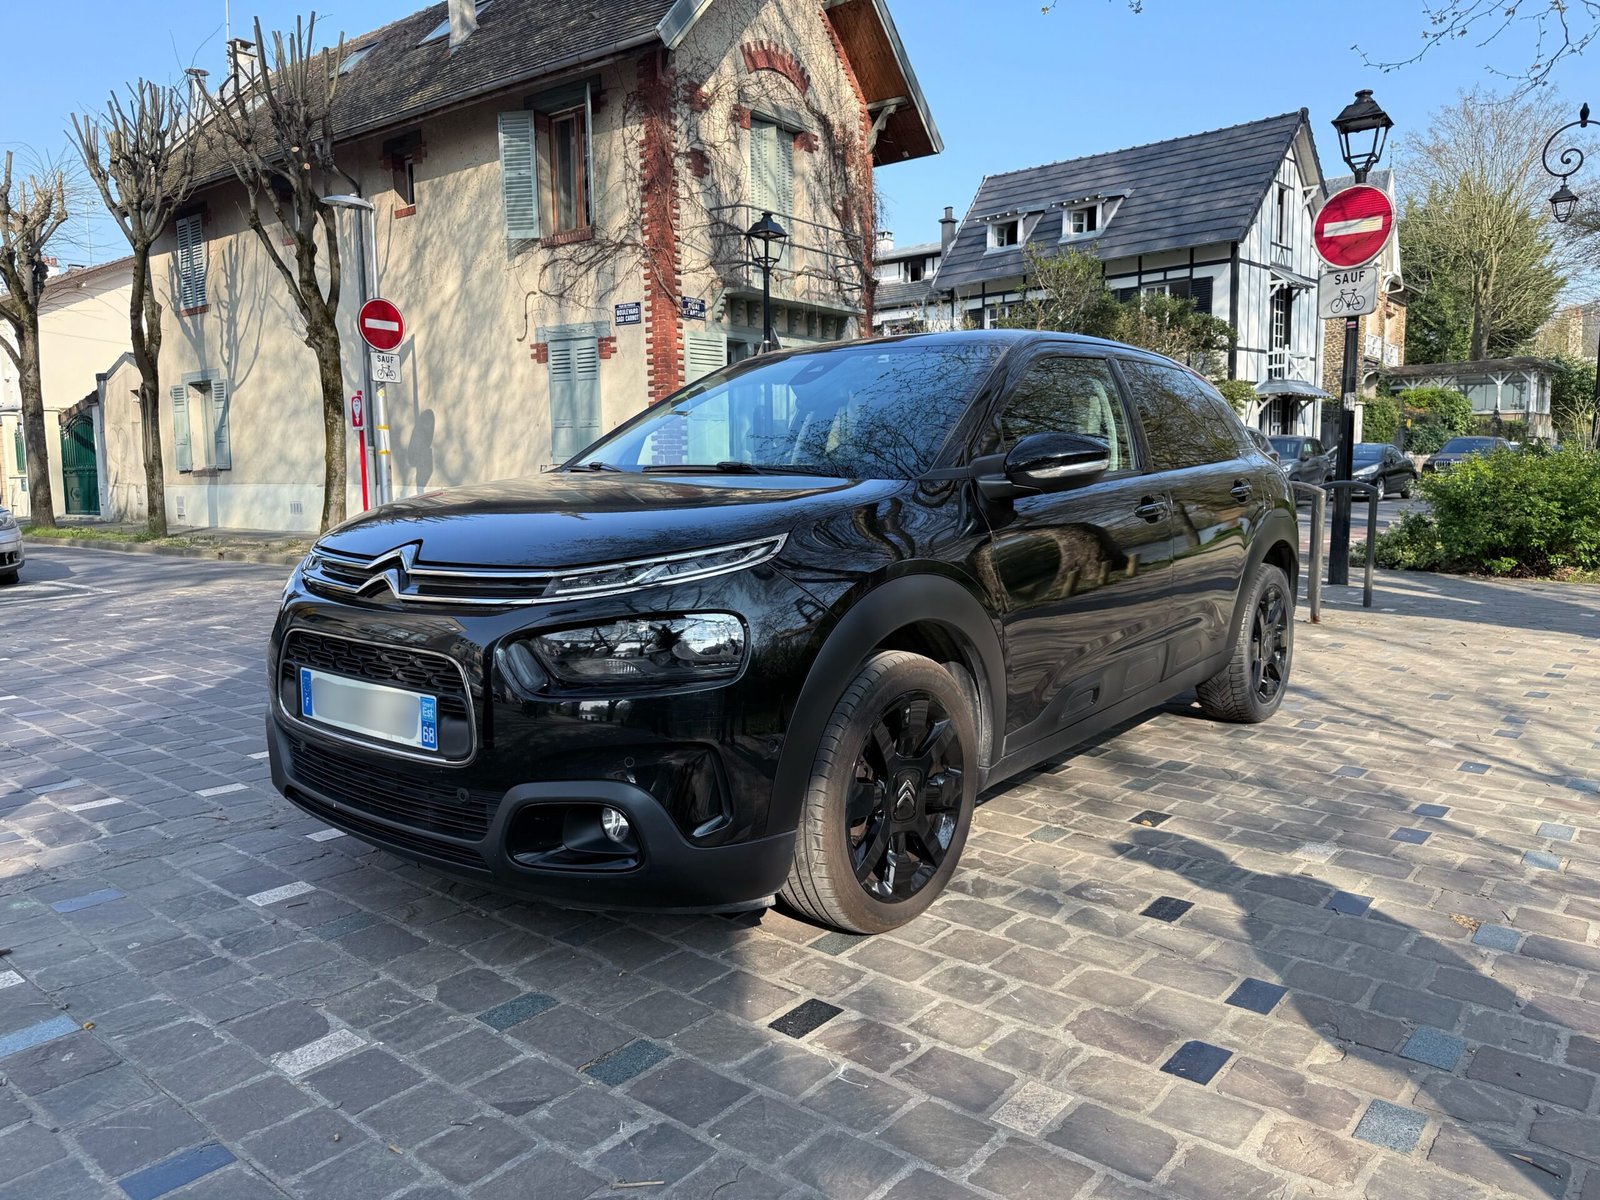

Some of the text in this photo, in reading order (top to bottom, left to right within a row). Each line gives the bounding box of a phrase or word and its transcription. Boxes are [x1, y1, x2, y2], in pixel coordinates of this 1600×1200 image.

[1334, 271, 1366, 285] SAUF
[616, 307, 639, 316] BOULEVARD
[625, 314, 639, 322] CARNOT
[376, 354, 394, 364] SAUF
[423, 707, 433, 717] Est
[423, 726, 434, 743] 68
